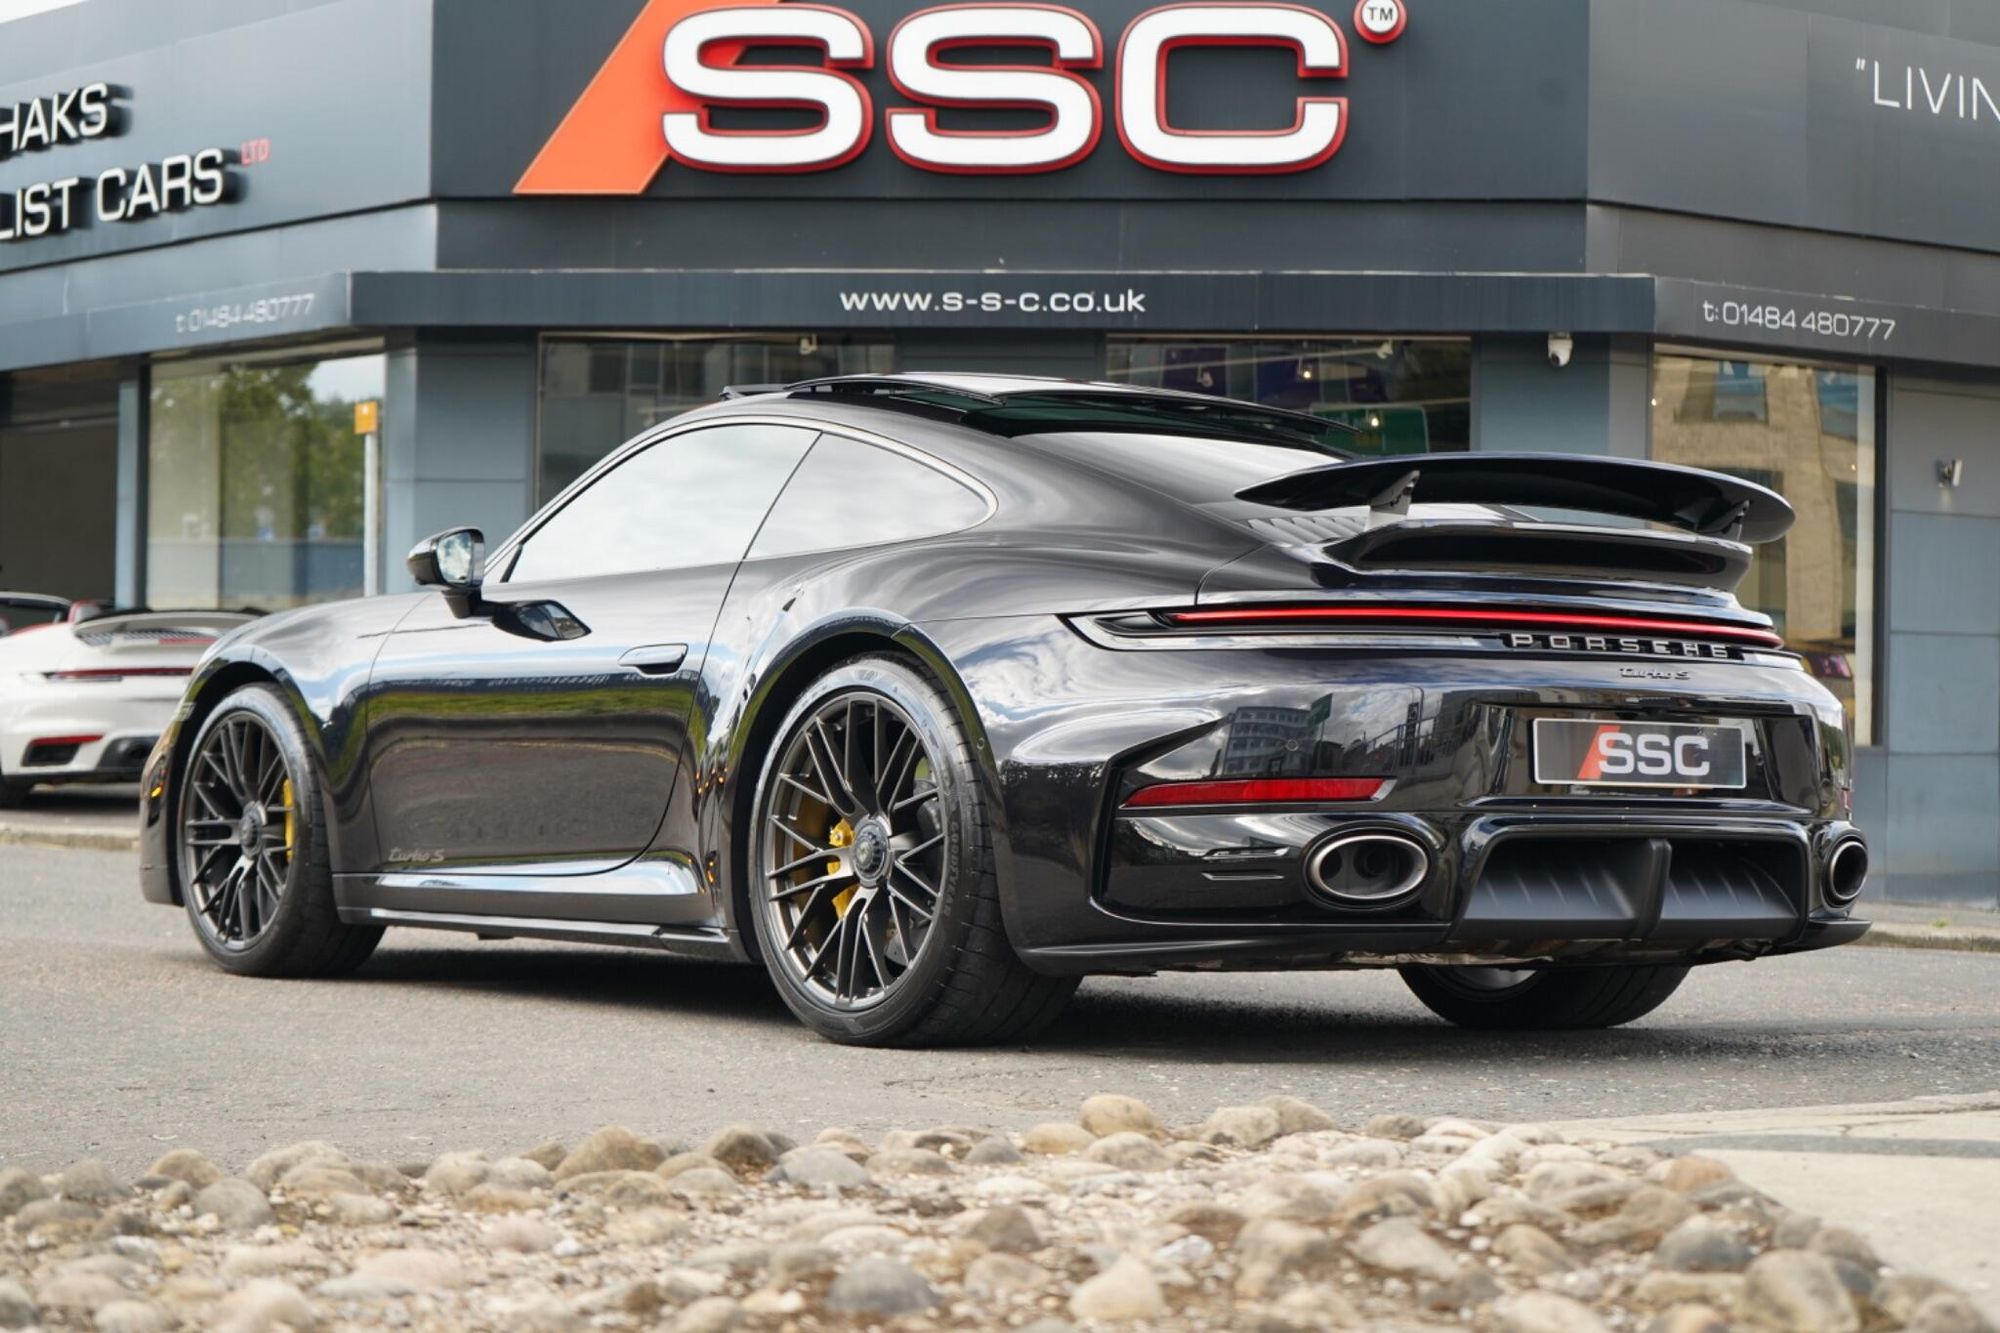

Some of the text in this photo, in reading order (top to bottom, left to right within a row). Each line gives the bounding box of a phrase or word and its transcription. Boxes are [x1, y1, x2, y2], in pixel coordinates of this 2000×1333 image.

[1368, 7, 1393, 21] TM
[661, 4, 1349, 175] SSC
[241, 138, 271, 166] LTD
[97, 148, 224, 222] CARS
[840, 289, 1146, 312] www.s-s-c.co.uk
[1801, 312, 1896, 340] 480777
[1510, 633, 1728, 658] PORSCHE
[1598, 732, 1710, 777] SSC
[430, 849, 445, 862] S
[944, 821, 959, 916] GOODYEAR
